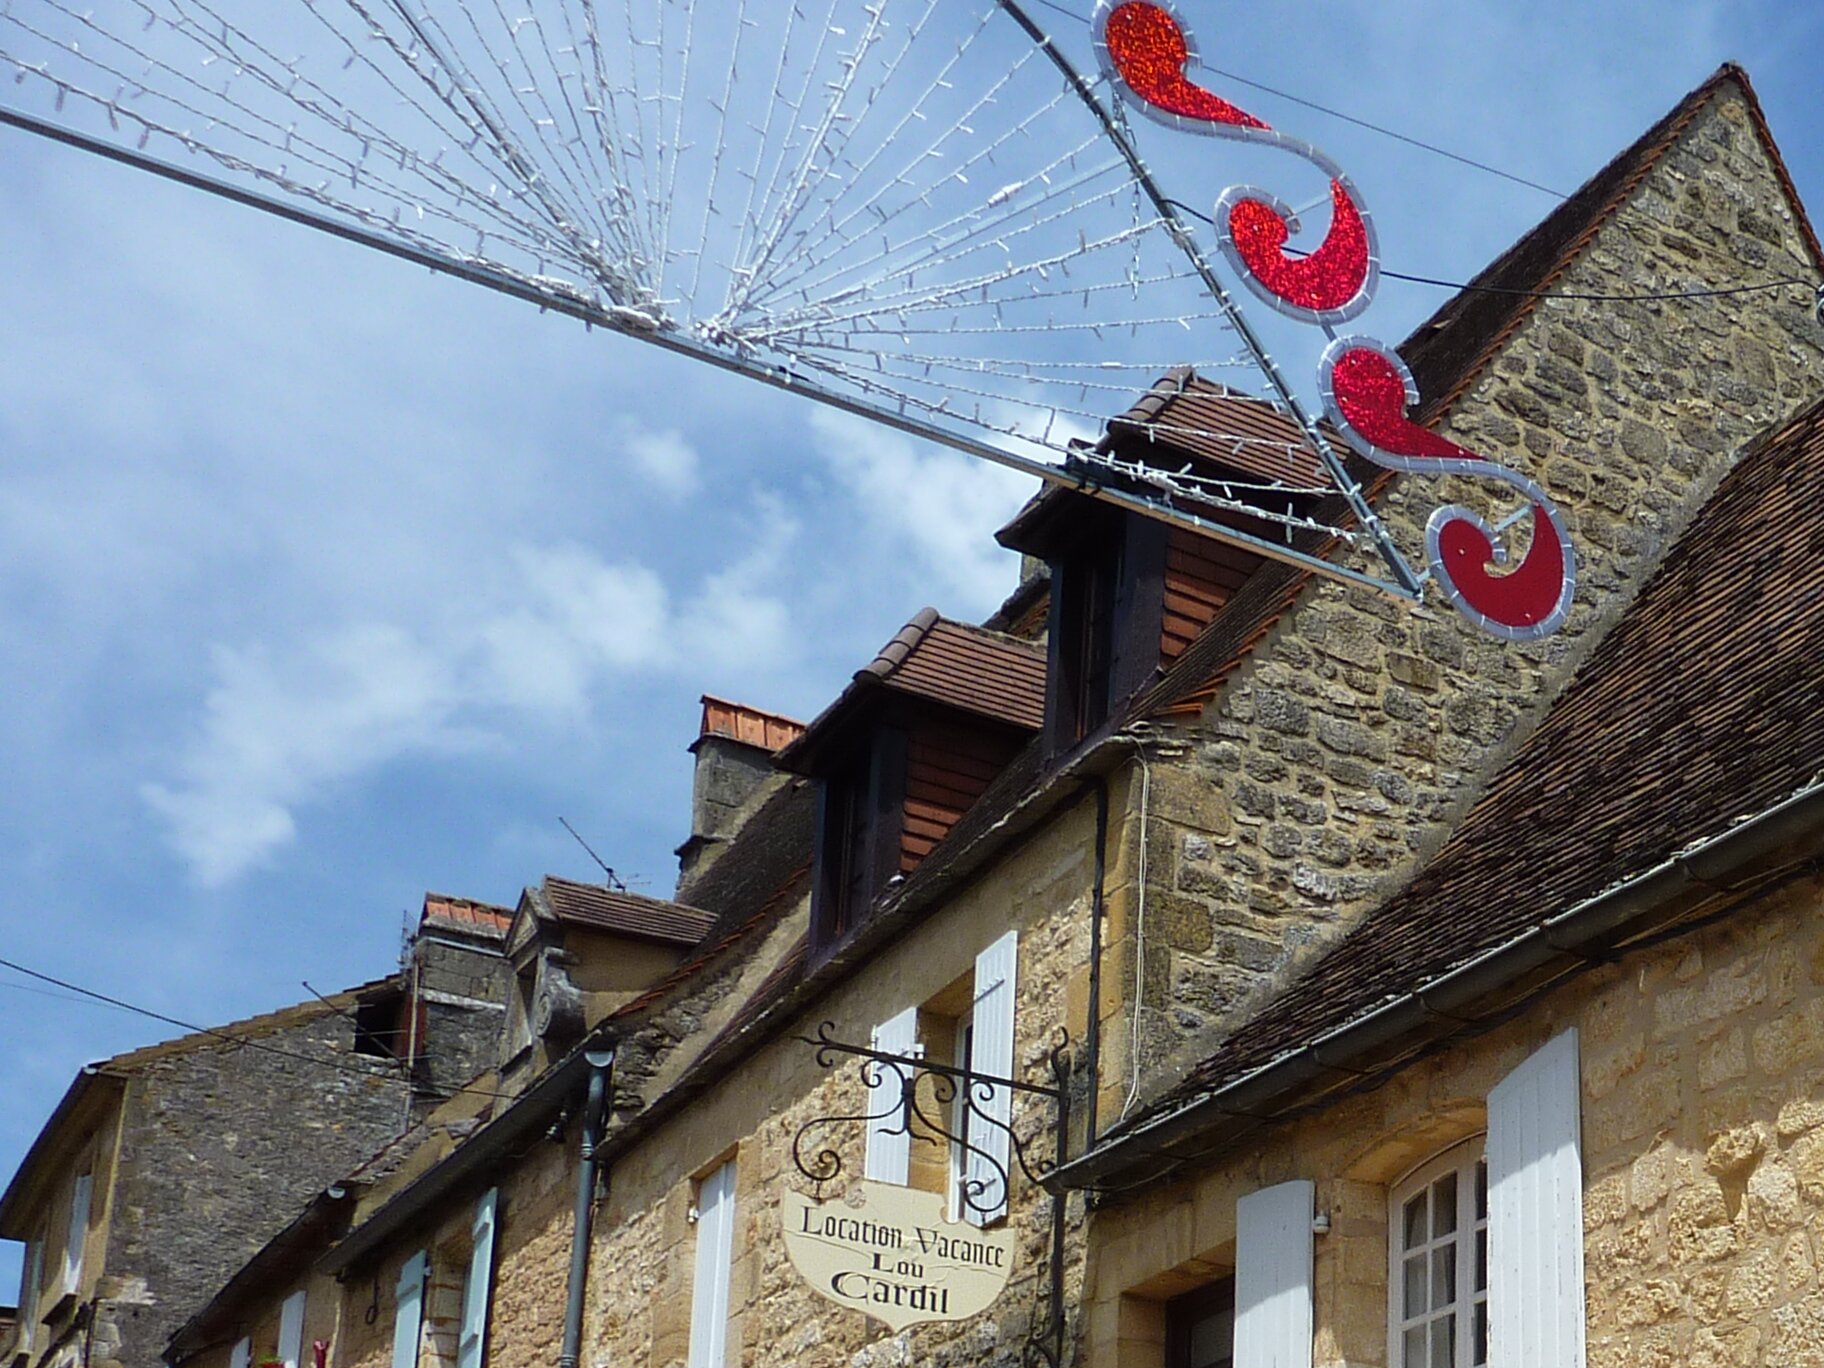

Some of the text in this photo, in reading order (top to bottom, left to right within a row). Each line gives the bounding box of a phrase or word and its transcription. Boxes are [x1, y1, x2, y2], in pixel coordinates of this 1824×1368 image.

[801, 1205, 1004, 1268] Location Vacance
[872, 1252, 924, 1279] Lou
[831, 1270, 949, 1314] Cardil
